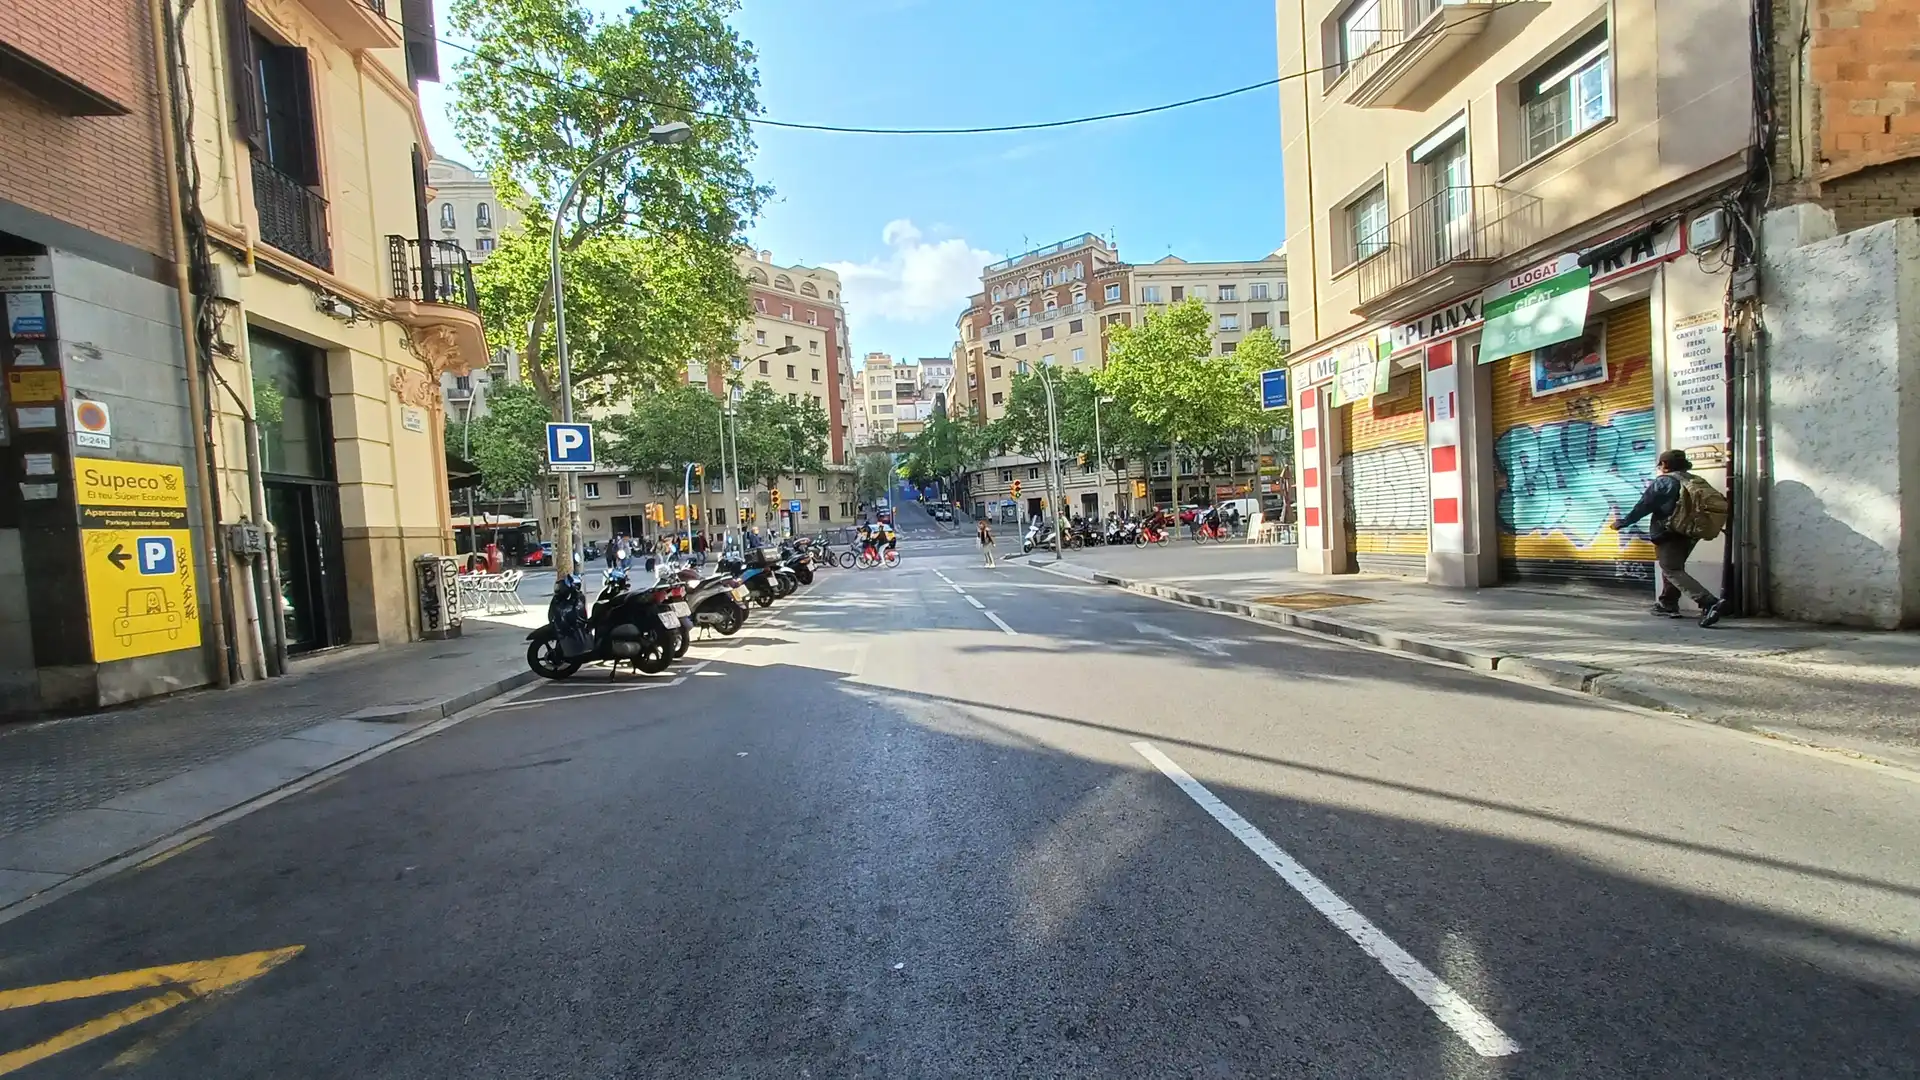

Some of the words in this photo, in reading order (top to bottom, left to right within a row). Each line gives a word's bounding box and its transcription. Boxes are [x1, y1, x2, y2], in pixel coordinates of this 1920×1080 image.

[1510, 261, 1558, 289] LLOGAT
[1676, 330, 1696, 340] CANVI
[1685, 338, 1706, 348] FRENS
[1677, 373, 1720, 386] AMORTIDORS
[1704, 402, 1716, 410] ITV
[556, 428, 583, 458] P
[85, 469, 159, 491] Supeco
[87, 491, 96, 499] El
[97, 492, 112, 500] teu
[84, 509, 137, 518] Aparcament
[161, 510, 185, 519] botiga
[144, 542, 166, 570] P
